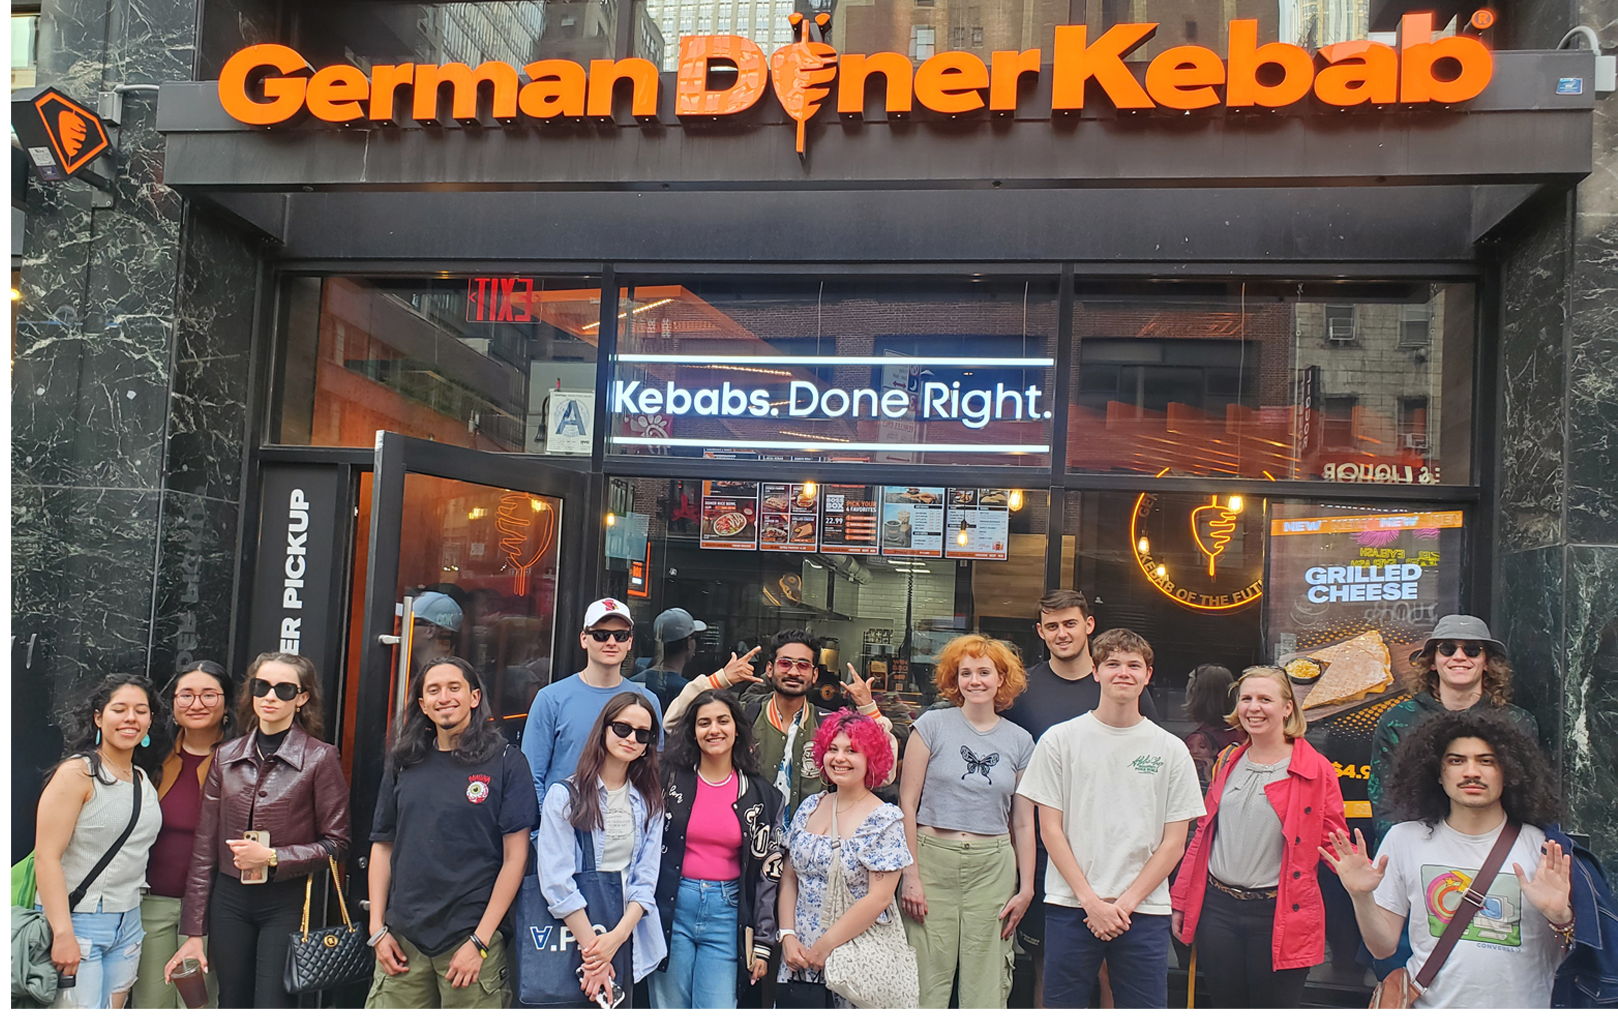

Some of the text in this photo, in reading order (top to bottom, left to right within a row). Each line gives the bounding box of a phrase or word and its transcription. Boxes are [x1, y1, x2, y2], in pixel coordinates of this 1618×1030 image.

[218, 44, 658, 125] German
[555, 399, 587, 436] A
[614, 380, 1053, 430] Kebabs. Done Right.
[1284, 520, 1322, 532] NEW
[283, 488, 310, 609] PICKUP
[1305, 564, 1422, 585] GRILLED
[1176, 588, 1197, 602] OF
[1200, 595, 1229, 606] THE
[1307, 582, 1418, 604] CHEESE
